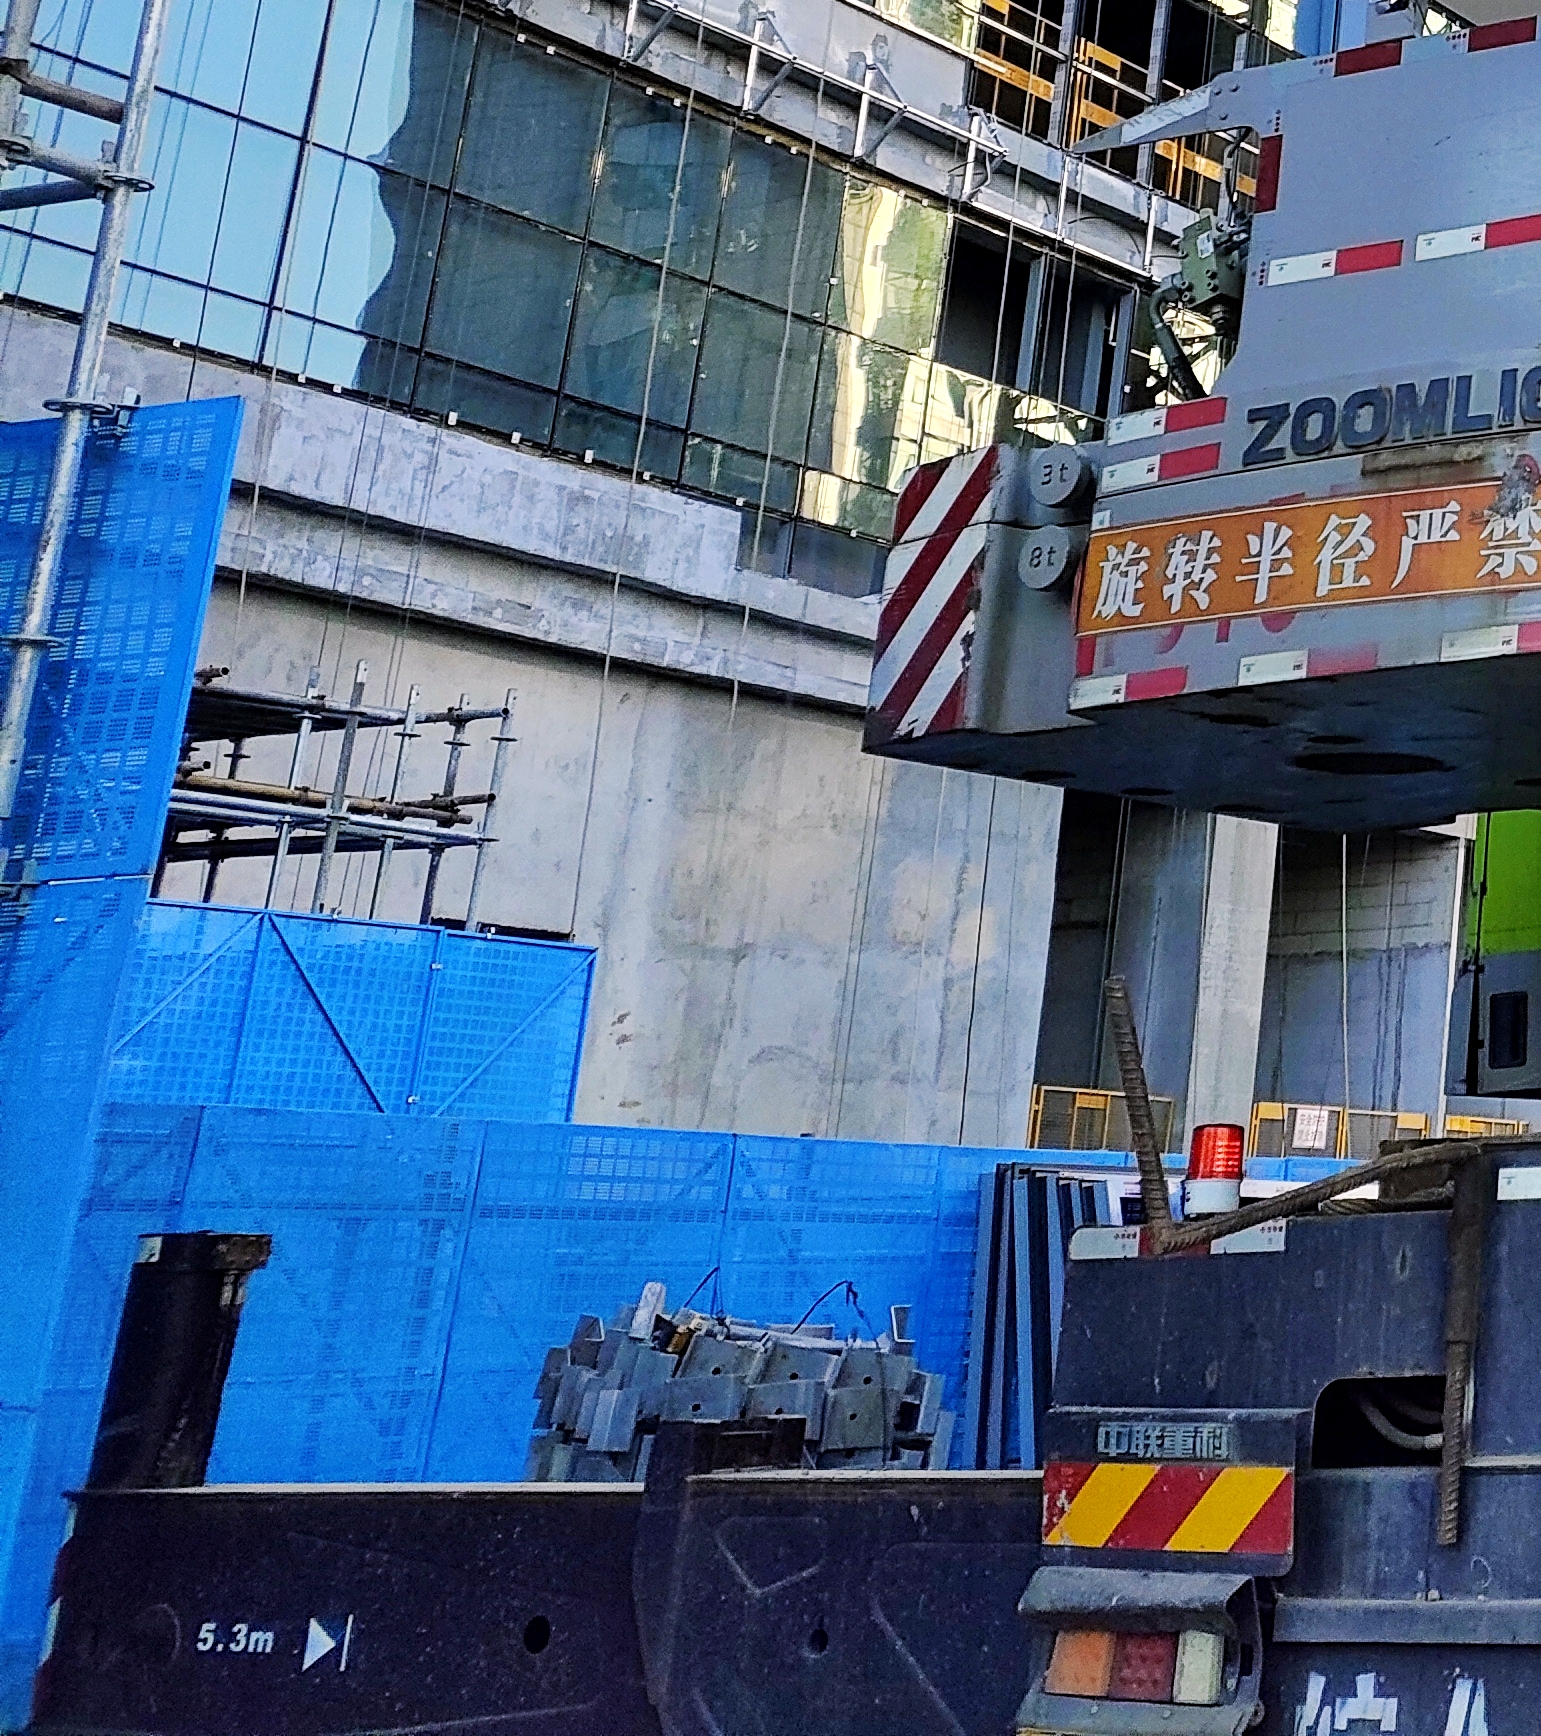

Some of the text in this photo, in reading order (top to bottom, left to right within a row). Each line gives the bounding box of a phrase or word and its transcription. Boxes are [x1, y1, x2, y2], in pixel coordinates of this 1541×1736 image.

[1097, 1423, 1232, 1460] 中联重科
[195, 1621, 274, 1655] 5.3m
